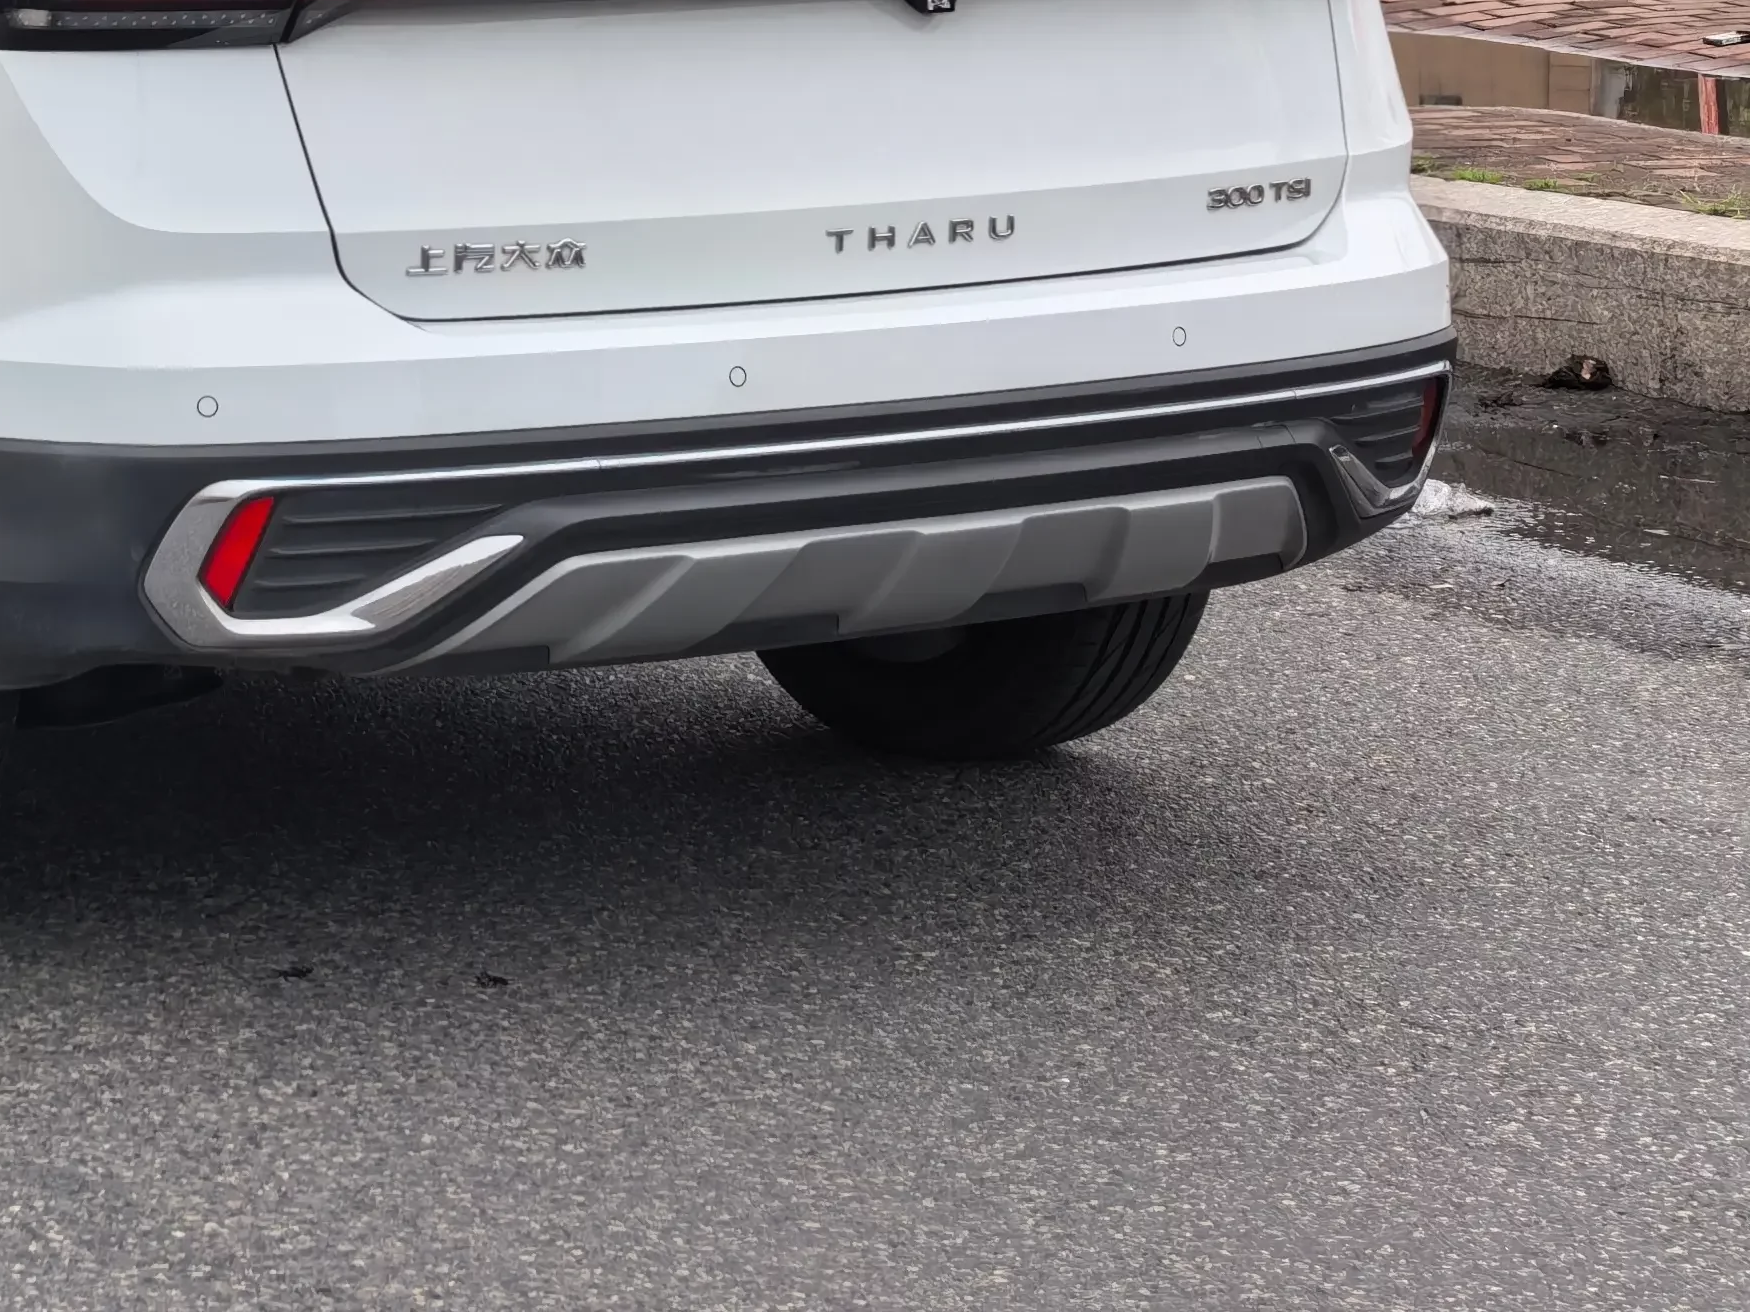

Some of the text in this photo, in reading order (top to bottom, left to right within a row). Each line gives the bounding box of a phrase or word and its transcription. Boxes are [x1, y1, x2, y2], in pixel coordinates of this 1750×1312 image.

[1206, 177, 1312, 212] 300 TSI
[825, 214, 1015, 255] THARU
[406, 238, 588, 277] 上汽大众
